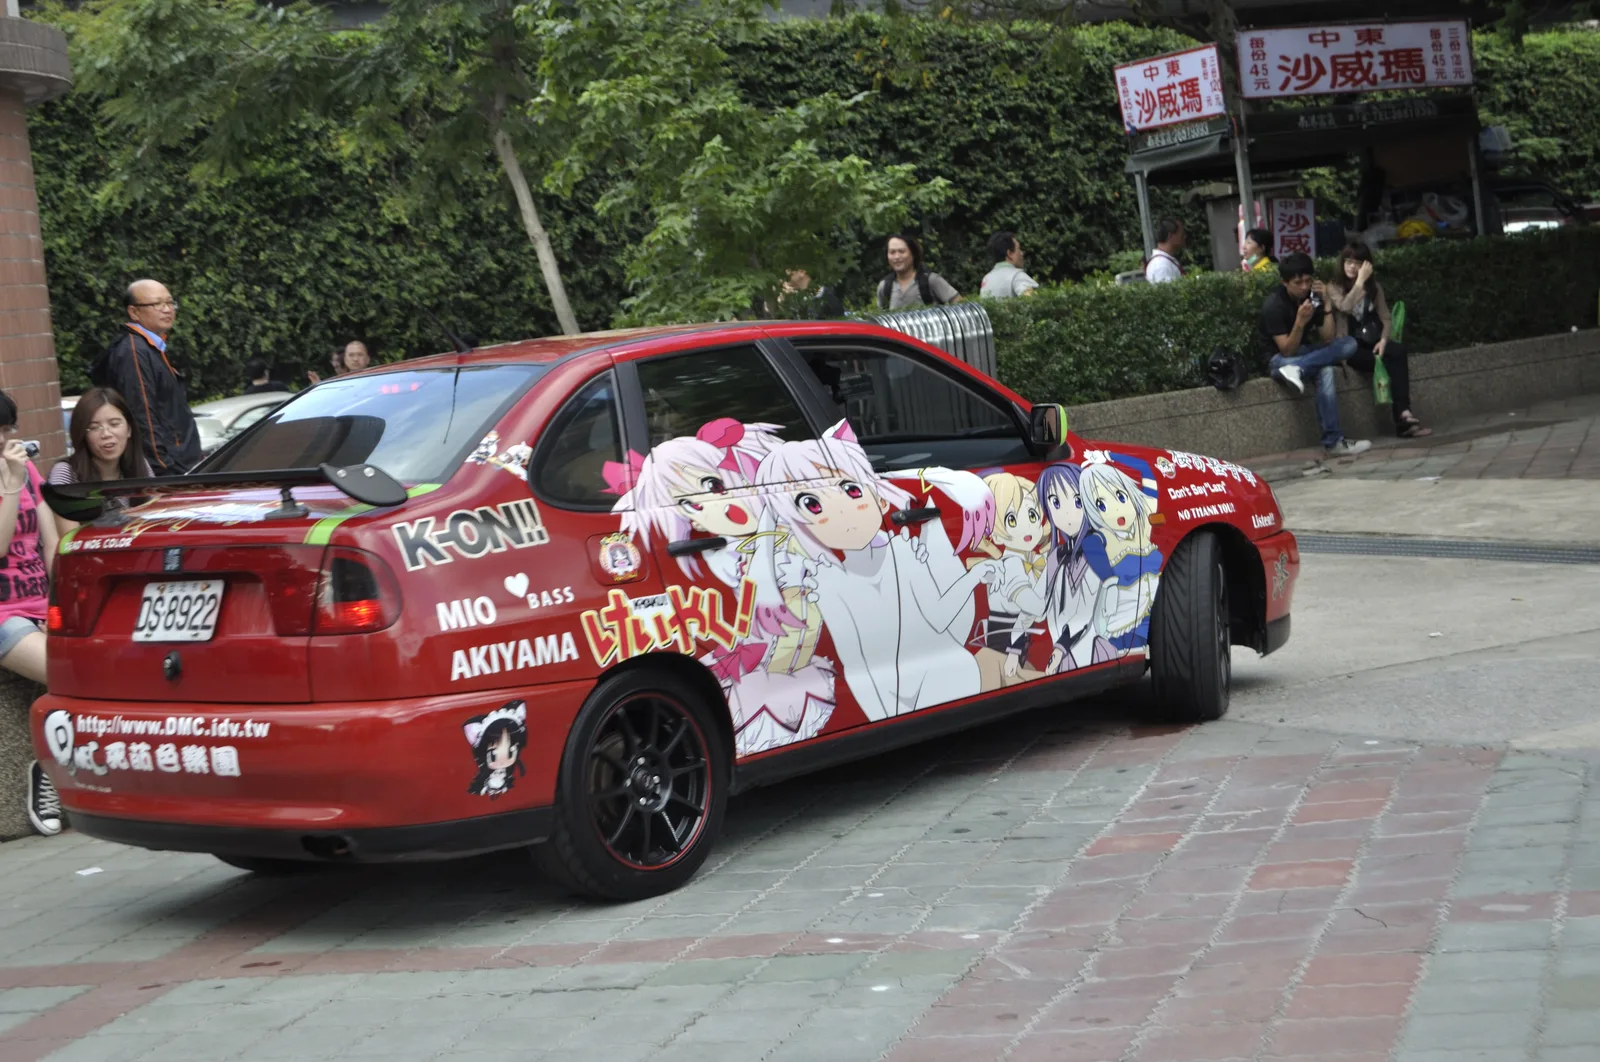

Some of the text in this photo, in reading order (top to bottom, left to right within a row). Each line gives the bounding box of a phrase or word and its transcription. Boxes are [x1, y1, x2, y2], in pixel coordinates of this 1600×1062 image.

[1308, 28, 1385, 49] 中東
[1143, 59, 1182, 82] 中東
[1277, 47, 1426, 92] 沙威瑪
[1134, 77, 1203, 124] 沙威瑪
[1167, 486, 1192, 500] Don't
[1190, 483, 1208, 497] Say
[1177, 509, 1191, 521] NO
[1190, 503, 1219, 519] THANK
[103, 537, 133, 549] COLOR
[392, 498, 550, 572] K-ON!!
[526, 586, 575, 609] BASS
[435, 596, 497, 631] MIO
[451, 632, 579, 681] AKIYAMA
[76, 714, 271, 738] http://www.DMC.idv.tw
